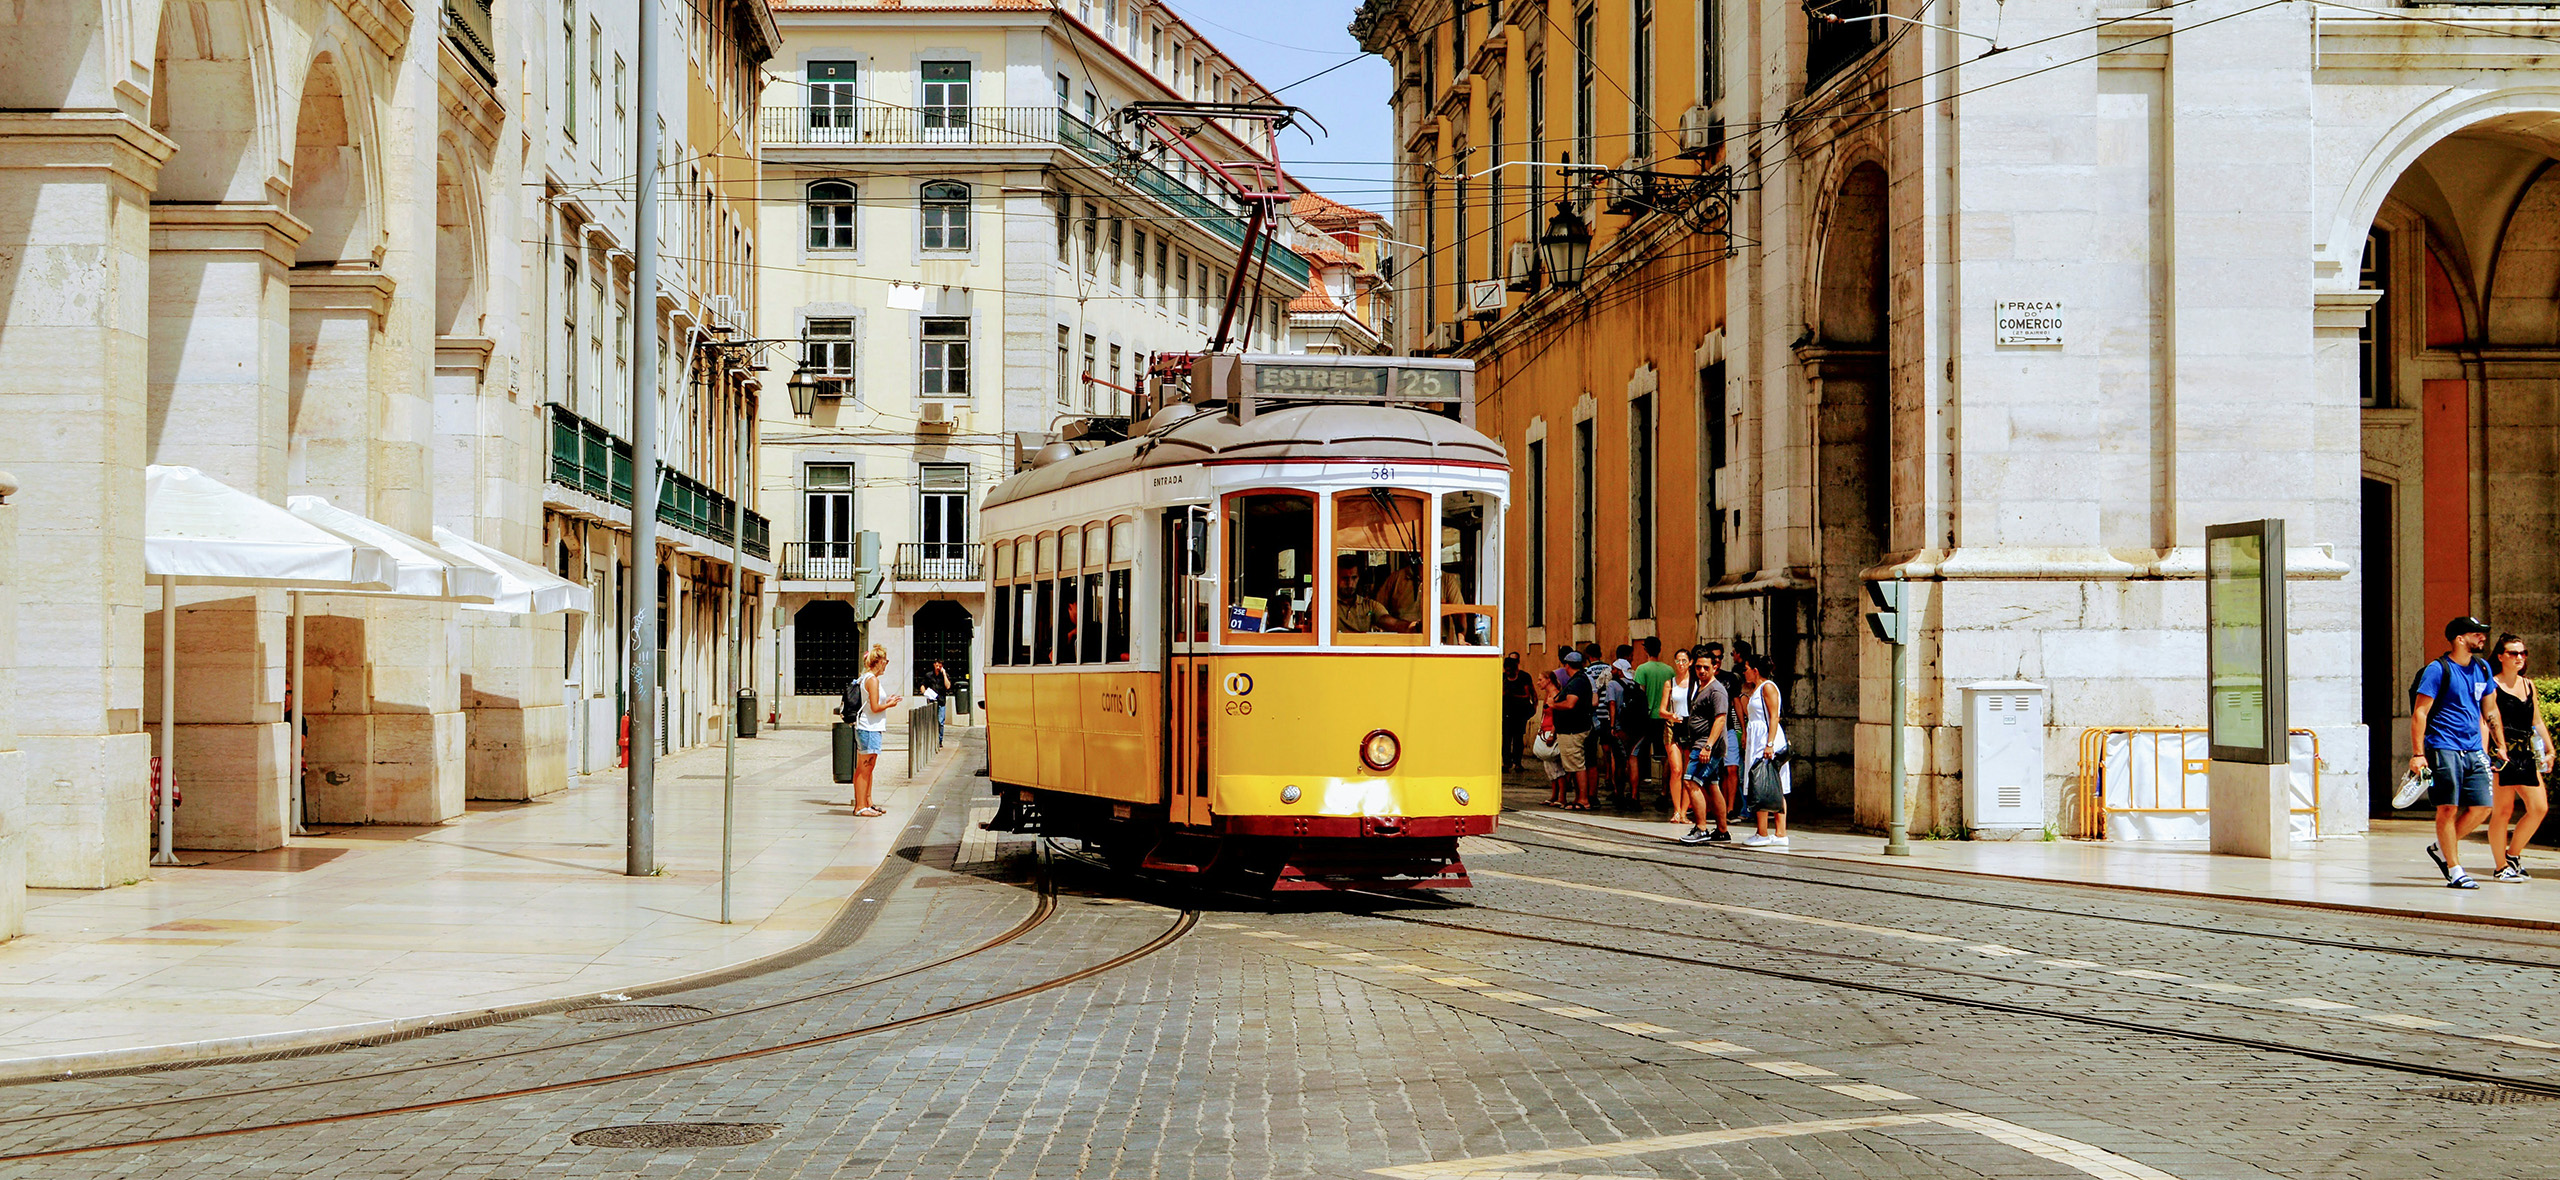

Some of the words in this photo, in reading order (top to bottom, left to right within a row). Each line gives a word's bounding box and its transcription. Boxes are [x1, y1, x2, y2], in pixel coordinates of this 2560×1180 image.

[2008, 302, 2054, 313] PRAÇA
[1999, 319, 2062, 329] COMERCIO
[1263, 369, 1378, 389] ESTRELA
[1403, 370, 1441, 395] 25
[1371, 468, 1395, 480] 581
[1153, 475, 1183, 487] ENTRADA
[1233, 608, 1246, 616] 25E
[1230, 619, 1242, 629] 01
[1101, 685, 1123, 713] carris
